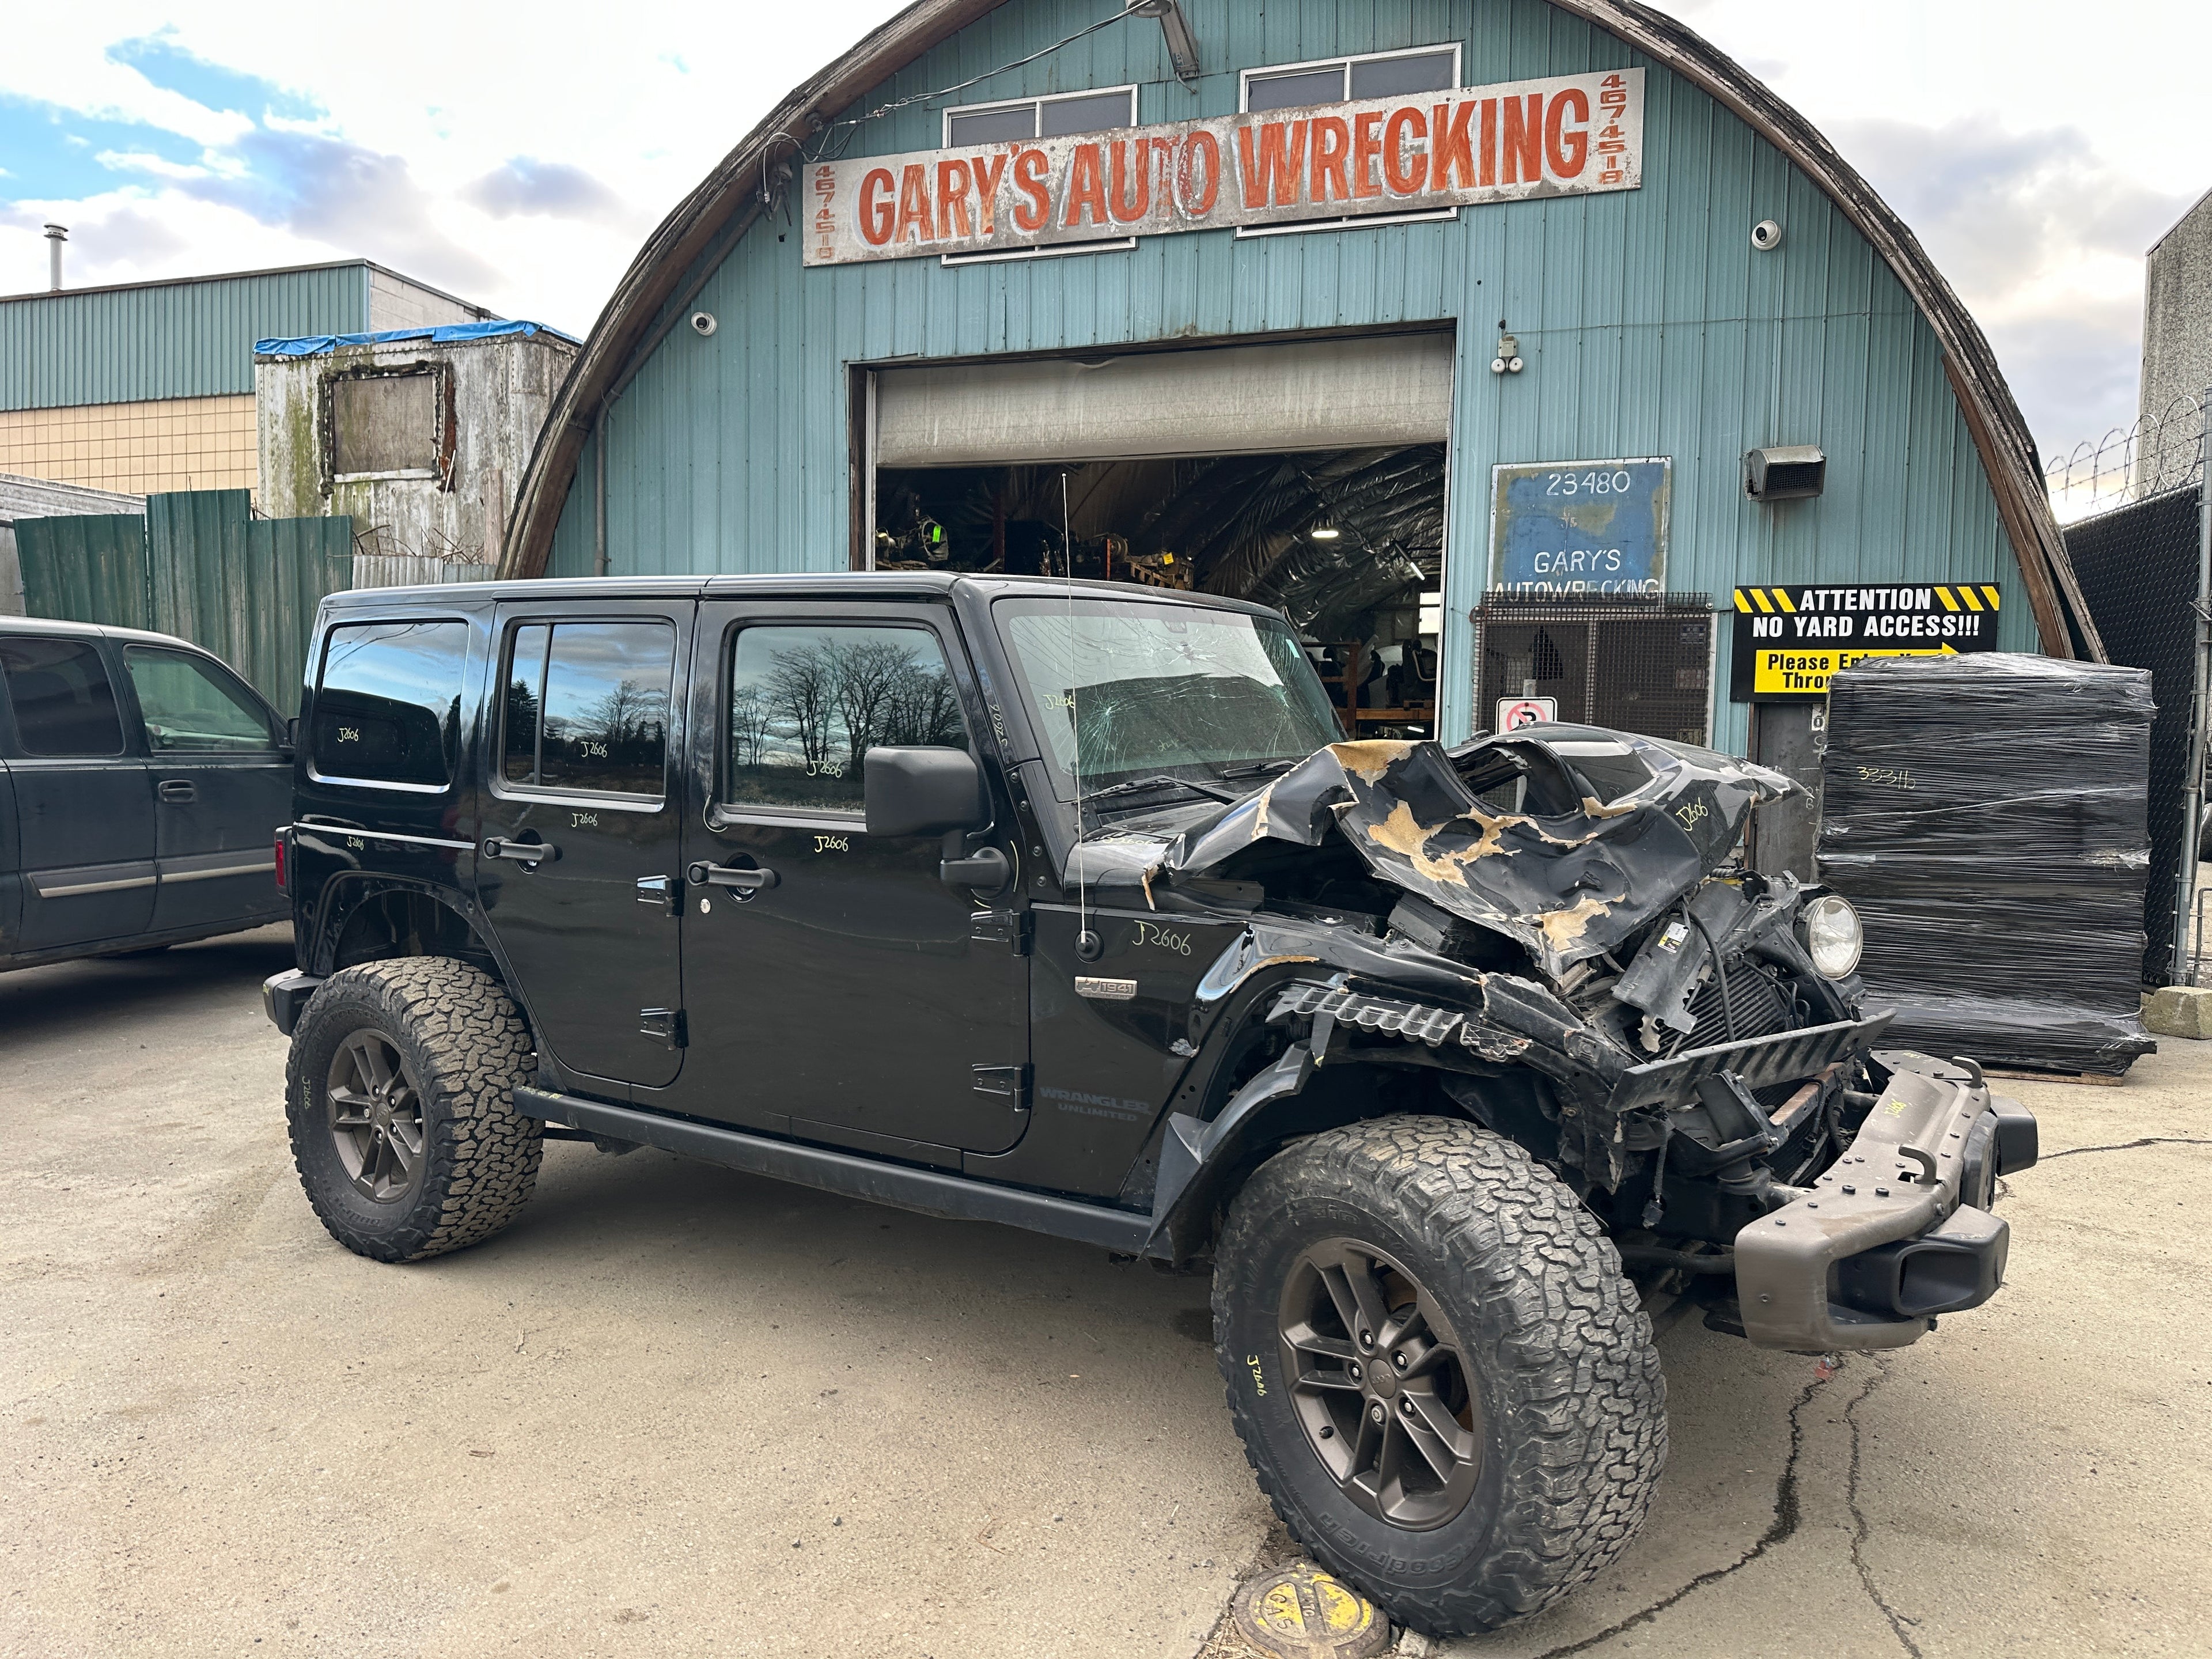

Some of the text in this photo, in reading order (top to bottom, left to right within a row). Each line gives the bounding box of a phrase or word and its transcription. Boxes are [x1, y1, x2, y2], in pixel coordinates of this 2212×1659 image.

[858, 88, 1589, 246] GARY'S AUTO WRECKING
[1546, 471, 1631, 496] 23480
[1534, 549, 1621, 573] GARY'S
[1799, 588, 1931, 611] ATTENTION
[1752, 615, 1980, 638] NO YARD ACCESS!!!
[1768, 654, 1829, 671] Please
[1043, 695, 1076, 710] J2606
[337, 728, 359, 743] J2606
[581, 741, 608, 758] J2606
[806, 760, 842, 778] J2606
[571, 813, 598, 828] J2606
[1675, 797, 1709, 831] J2606
[814, 835, 849, 853] J2606
[1132, 920, 1191, 956] J2606
[1101, 983, 1132, 993] 1941
[1039, 1087, 1151, 1112] WRANGLER
[1058, 1103, 1138, 1122] UNLIMITED
[1264, 1593, 1294, 1630] GAS
